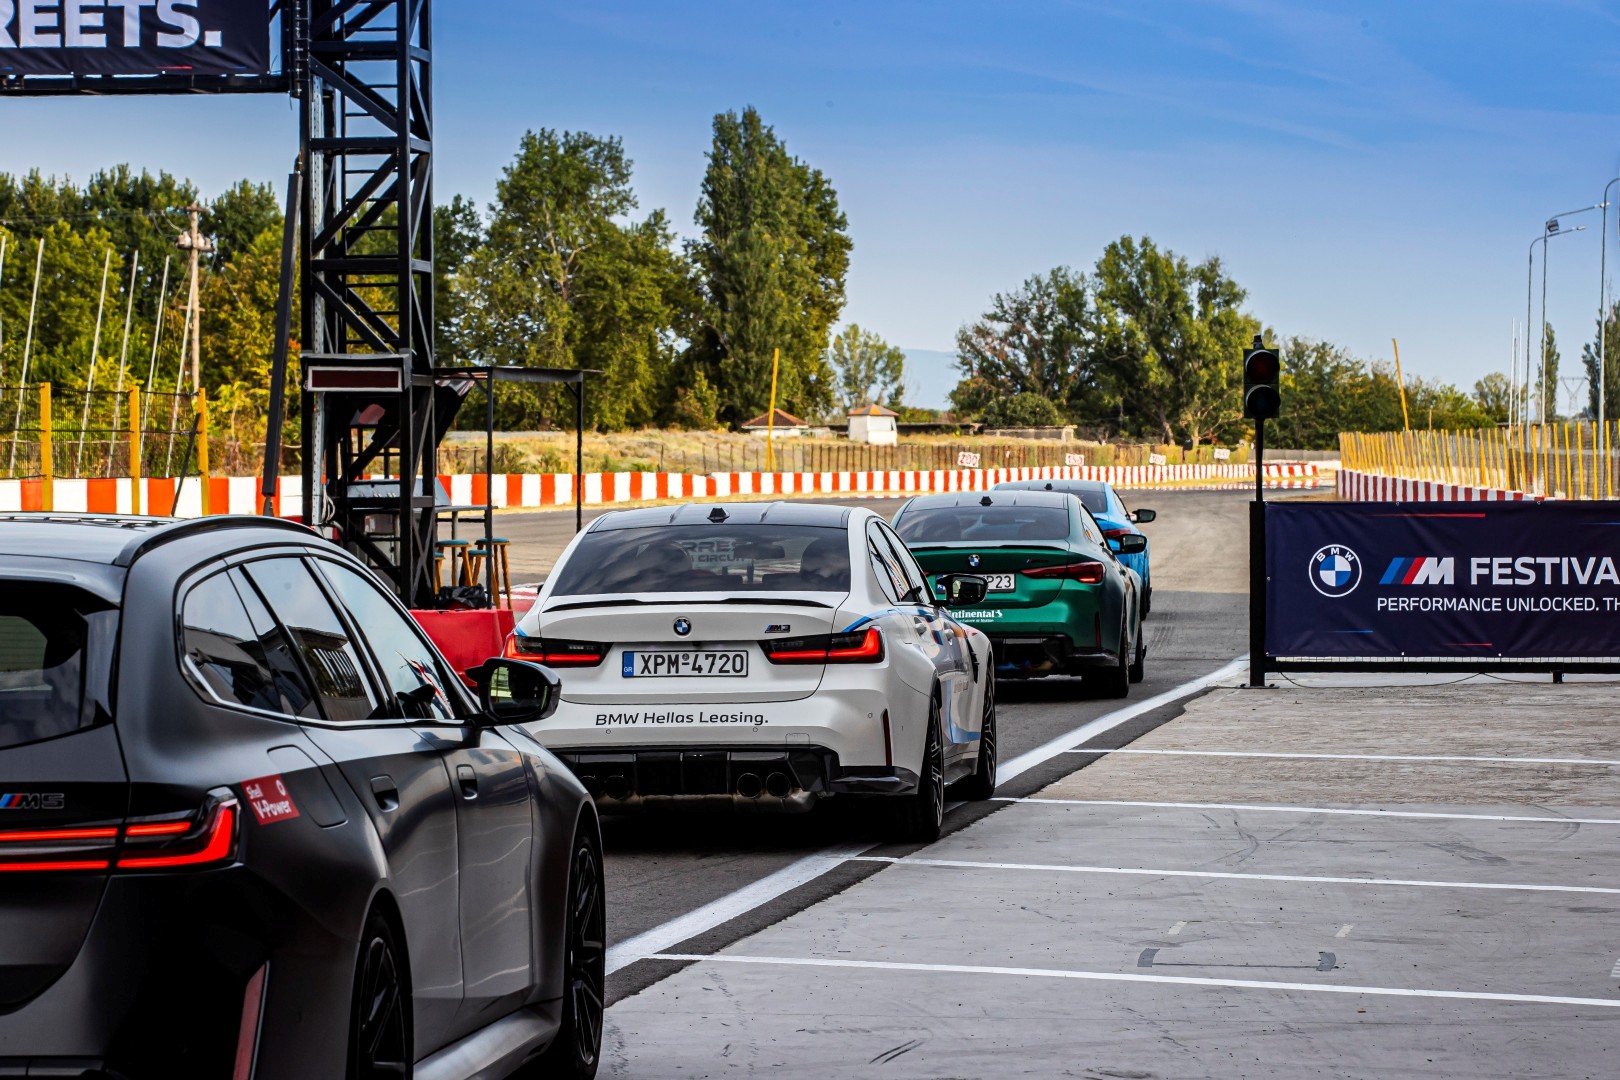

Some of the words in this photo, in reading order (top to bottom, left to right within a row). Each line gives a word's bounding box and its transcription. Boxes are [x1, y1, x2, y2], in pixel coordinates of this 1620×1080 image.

[1470, 557, 1620, 585] FESTIVA
[1377, 597, 1501, 611] PERFORMANCE
[1506, 597, 1599, 611] UNLOCKED.
[595, 713, 639, 725] BMW
[643, 712, 694, 724] Hellas
[699, 712, 769, 726] Leasing.
[252, 799, 292, 819] V-Power
